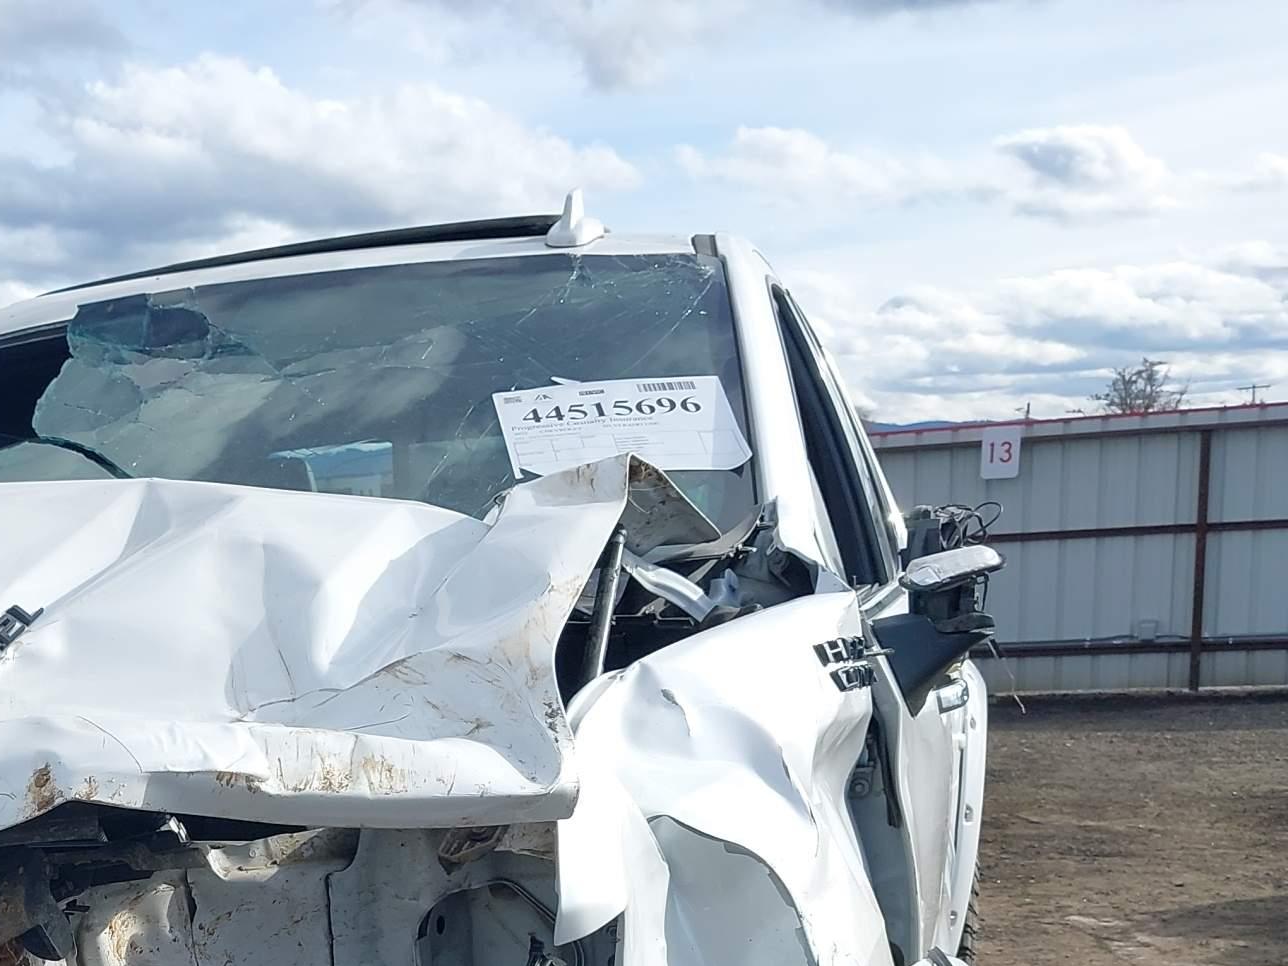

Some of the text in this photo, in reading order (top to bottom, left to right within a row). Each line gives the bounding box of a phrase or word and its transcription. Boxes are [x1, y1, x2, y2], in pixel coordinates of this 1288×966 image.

[523, 395, 702, 423] 44515696
[511, 422, 565, 432] Progressive
[989, 441, 1013, 464] 13
